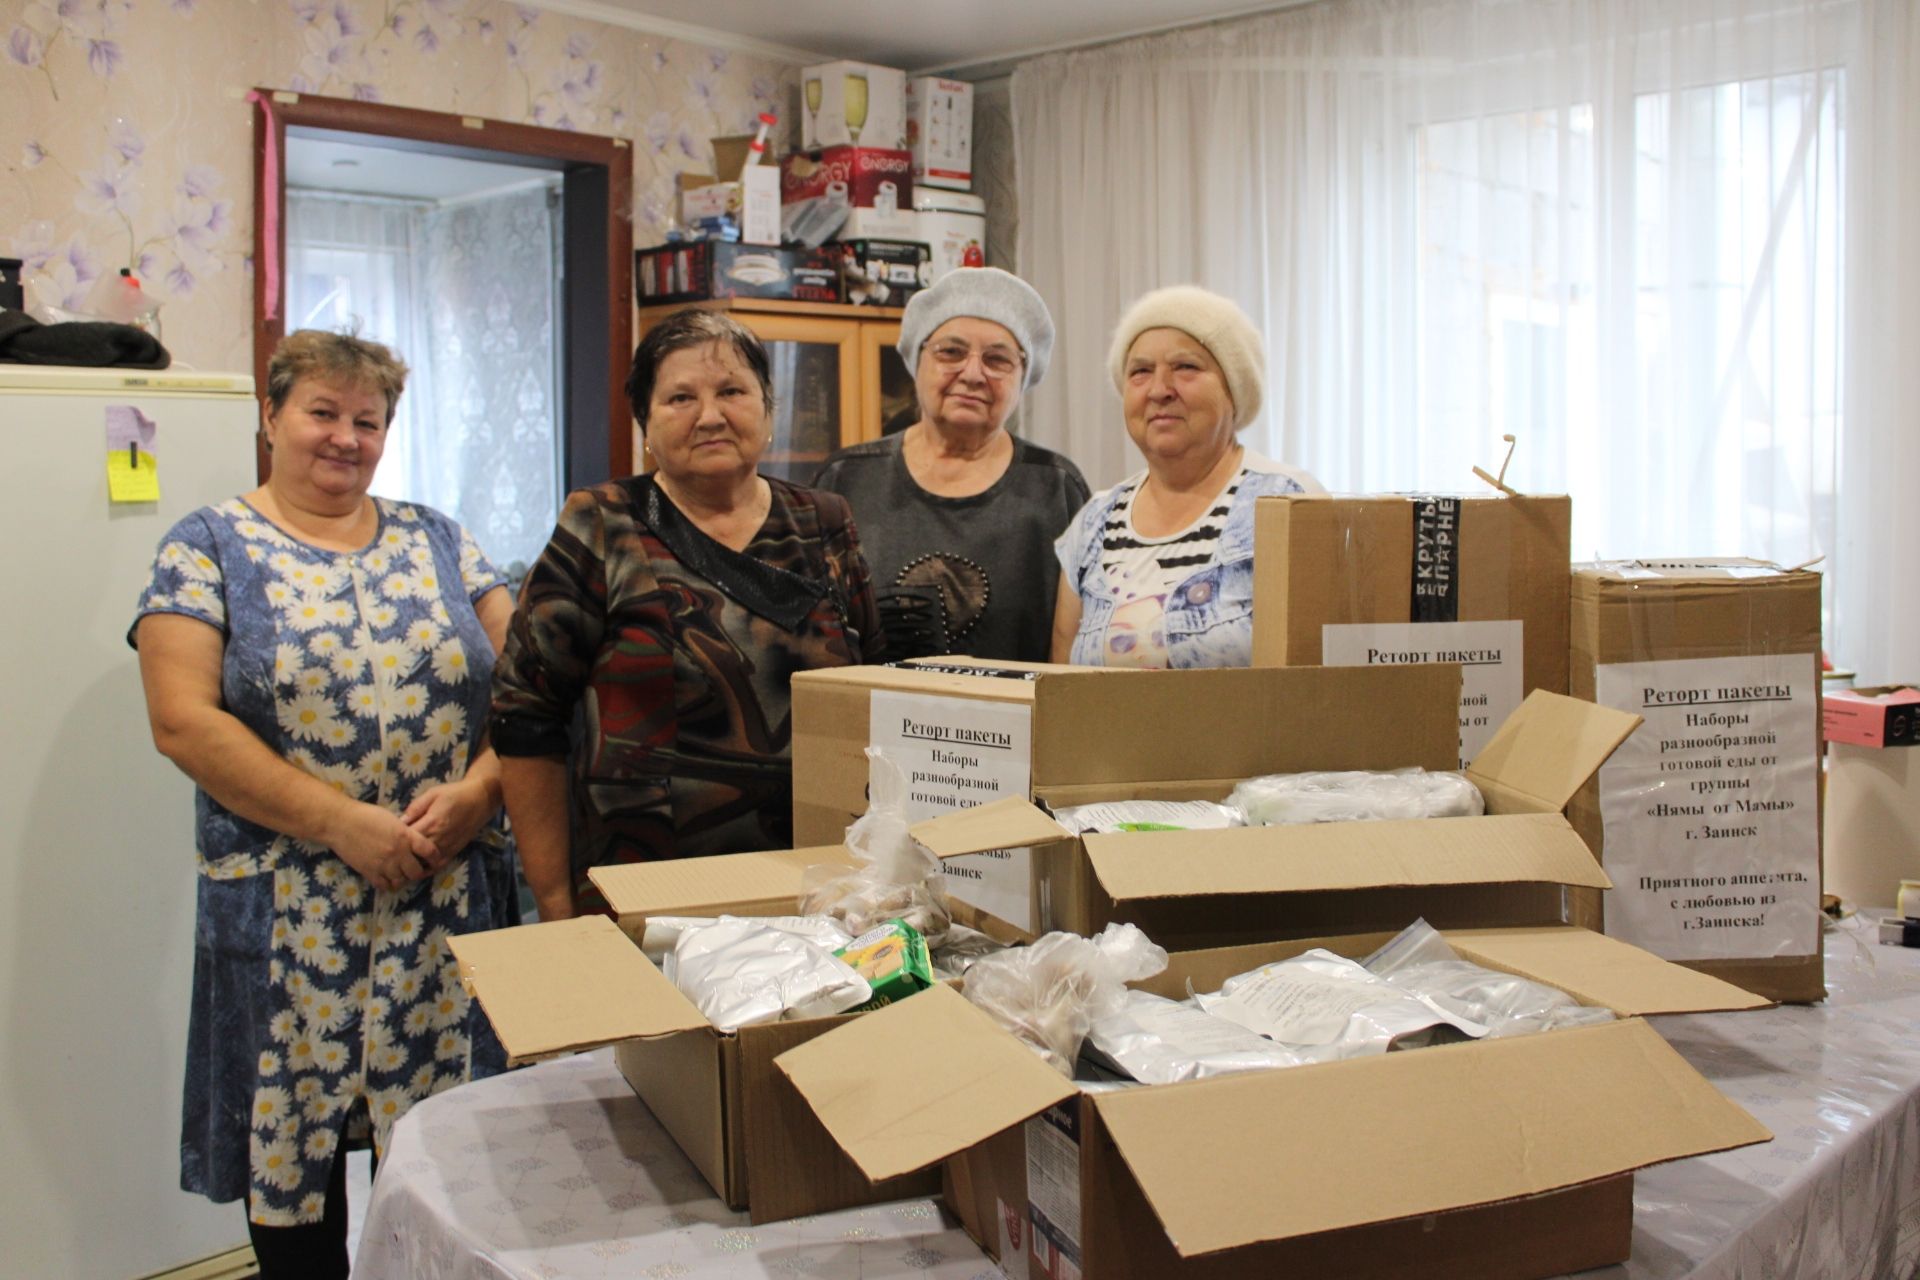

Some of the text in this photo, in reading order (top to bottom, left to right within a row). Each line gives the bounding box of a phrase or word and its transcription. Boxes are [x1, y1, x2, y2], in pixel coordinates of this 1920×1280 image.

[1367, 648, 1501, 664] Реторт пакеты
[1643, 684, 1792, 704] Реторт пакеты
[1686, 713, 1749, 728] Наборы
[902, 717, 1012, 746] Реторт пакеты
[1660, 731, 1777, 752] разнообразной
[931, 750, 979, 769] Наборы
[1660, 755, 1778, 772] готовой еды от
[912, 770, 999, 792] разнообразной
[1690, 778, 1750, 793] группы
[911, 792, 956, 807] готовой
[1647, 798, 1795, 818] «Нямы от Мамы»
[1702, 825, 1758, 840] Заинск
[941, 861, 983, 880] Заинск
[1639, 874, 1727, 892] Приятного
[1671, 894, 1777, 911] с любовью из
